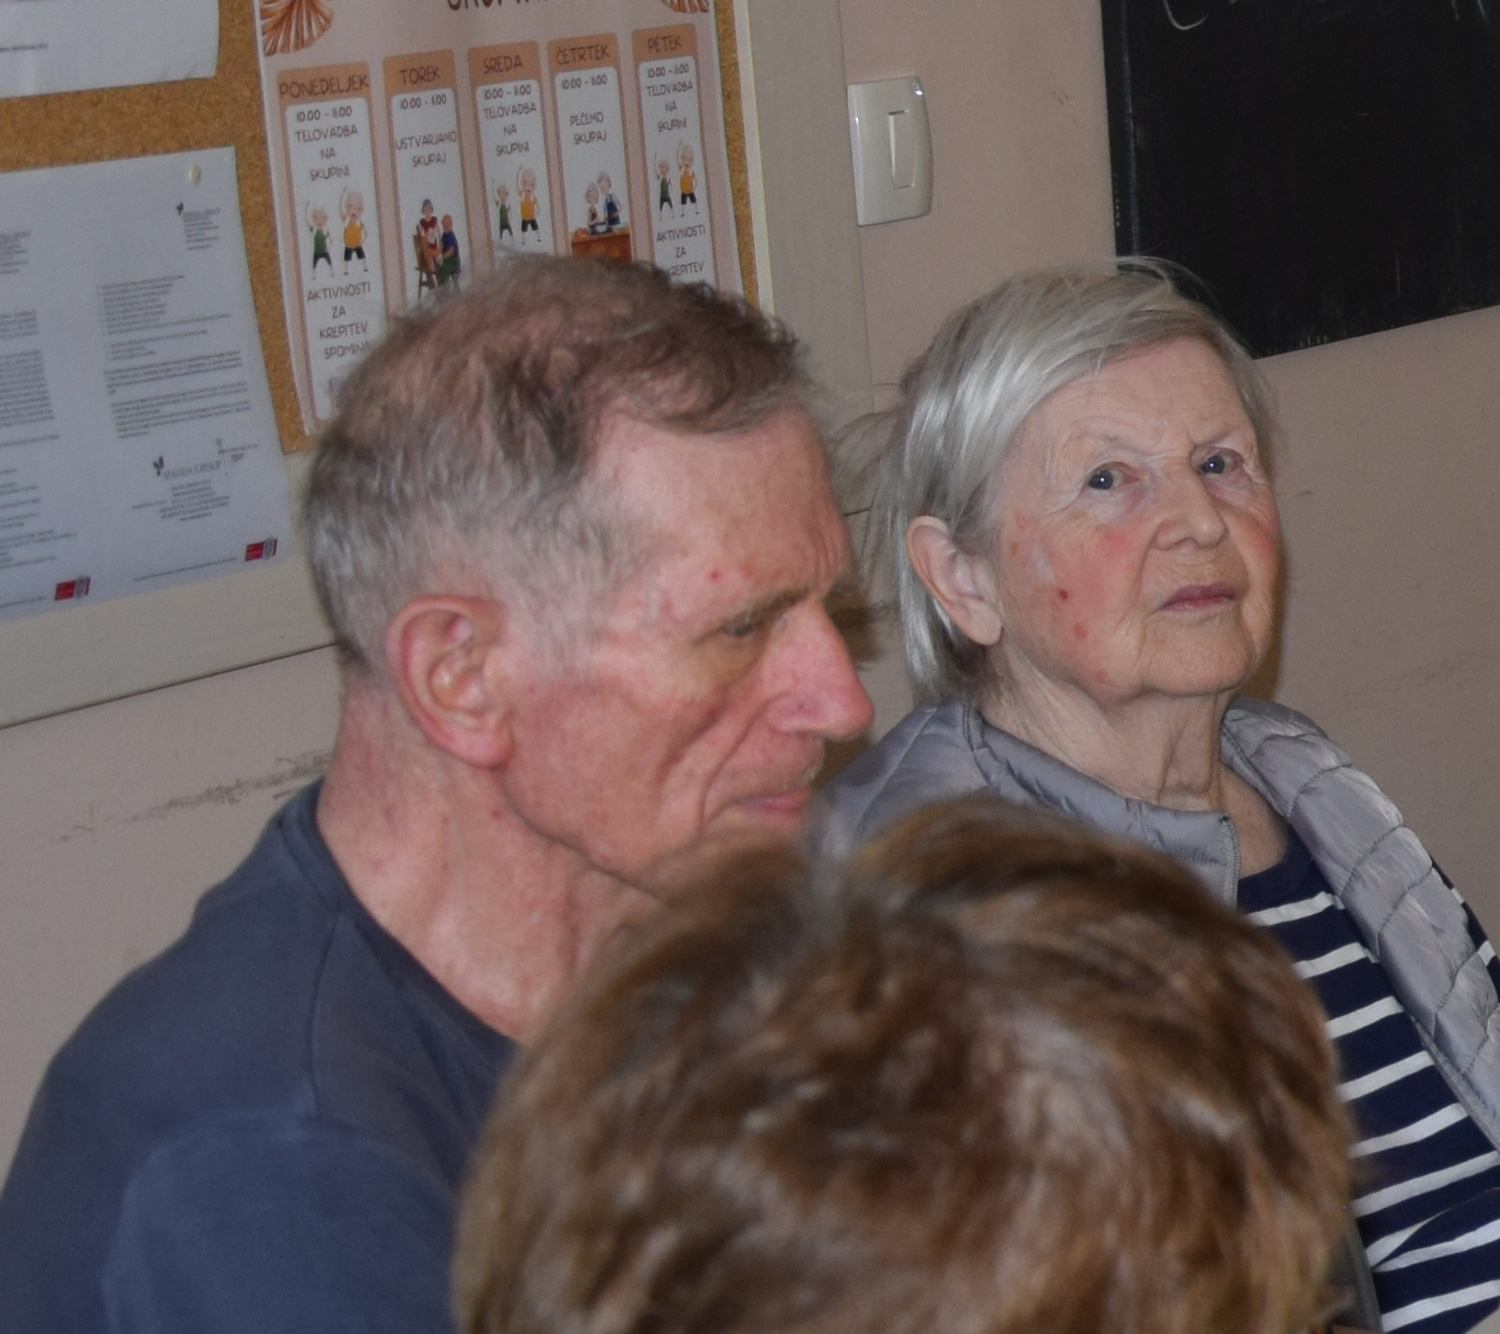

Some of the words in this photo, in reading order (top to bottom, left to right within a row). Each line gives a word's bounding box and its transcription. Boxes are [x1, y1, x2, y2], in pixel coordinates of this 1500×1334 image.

[647, 34, 683, 54] PETEK
[556, 43, 611, 66] ČETRTEK
[483, 54, 524, 75] SREDA
[399, 64, 442, 86] TOREK
[279, 74, 370, 99] PONEDELJEK
[646, 80, 694, 98] TELOVADBA
[483, 102, 537, 120] TELOVADBA
[665, 102, 678, 113] NA
[569, 111, 605, 127] PEČEMO
[657, 118, 688, 133] SKUPINI
[295, 124, 359, 143] TELOVADBA
[503, 124, 518, 136] NA
[573, 130, 608, 146] SKUPAJ
[396, 130, 458, 151] USTVARJAMO
[319, 147, 336, 160] NA
[496, 142, 530, 158] SKUPINI
[412, 152, 447, 168] SKUPAJ
[310, 165, 350, 182] SKUPINI
[656, 224, 706, 243] AKTIVNOSTI
[675, 247, 687, 259] ZA
[306, 281, 371, 302] AKTIVNOSTI
[331, 306, 347, 319] ZA
[319, 322, 369, 339] KREPITEV
